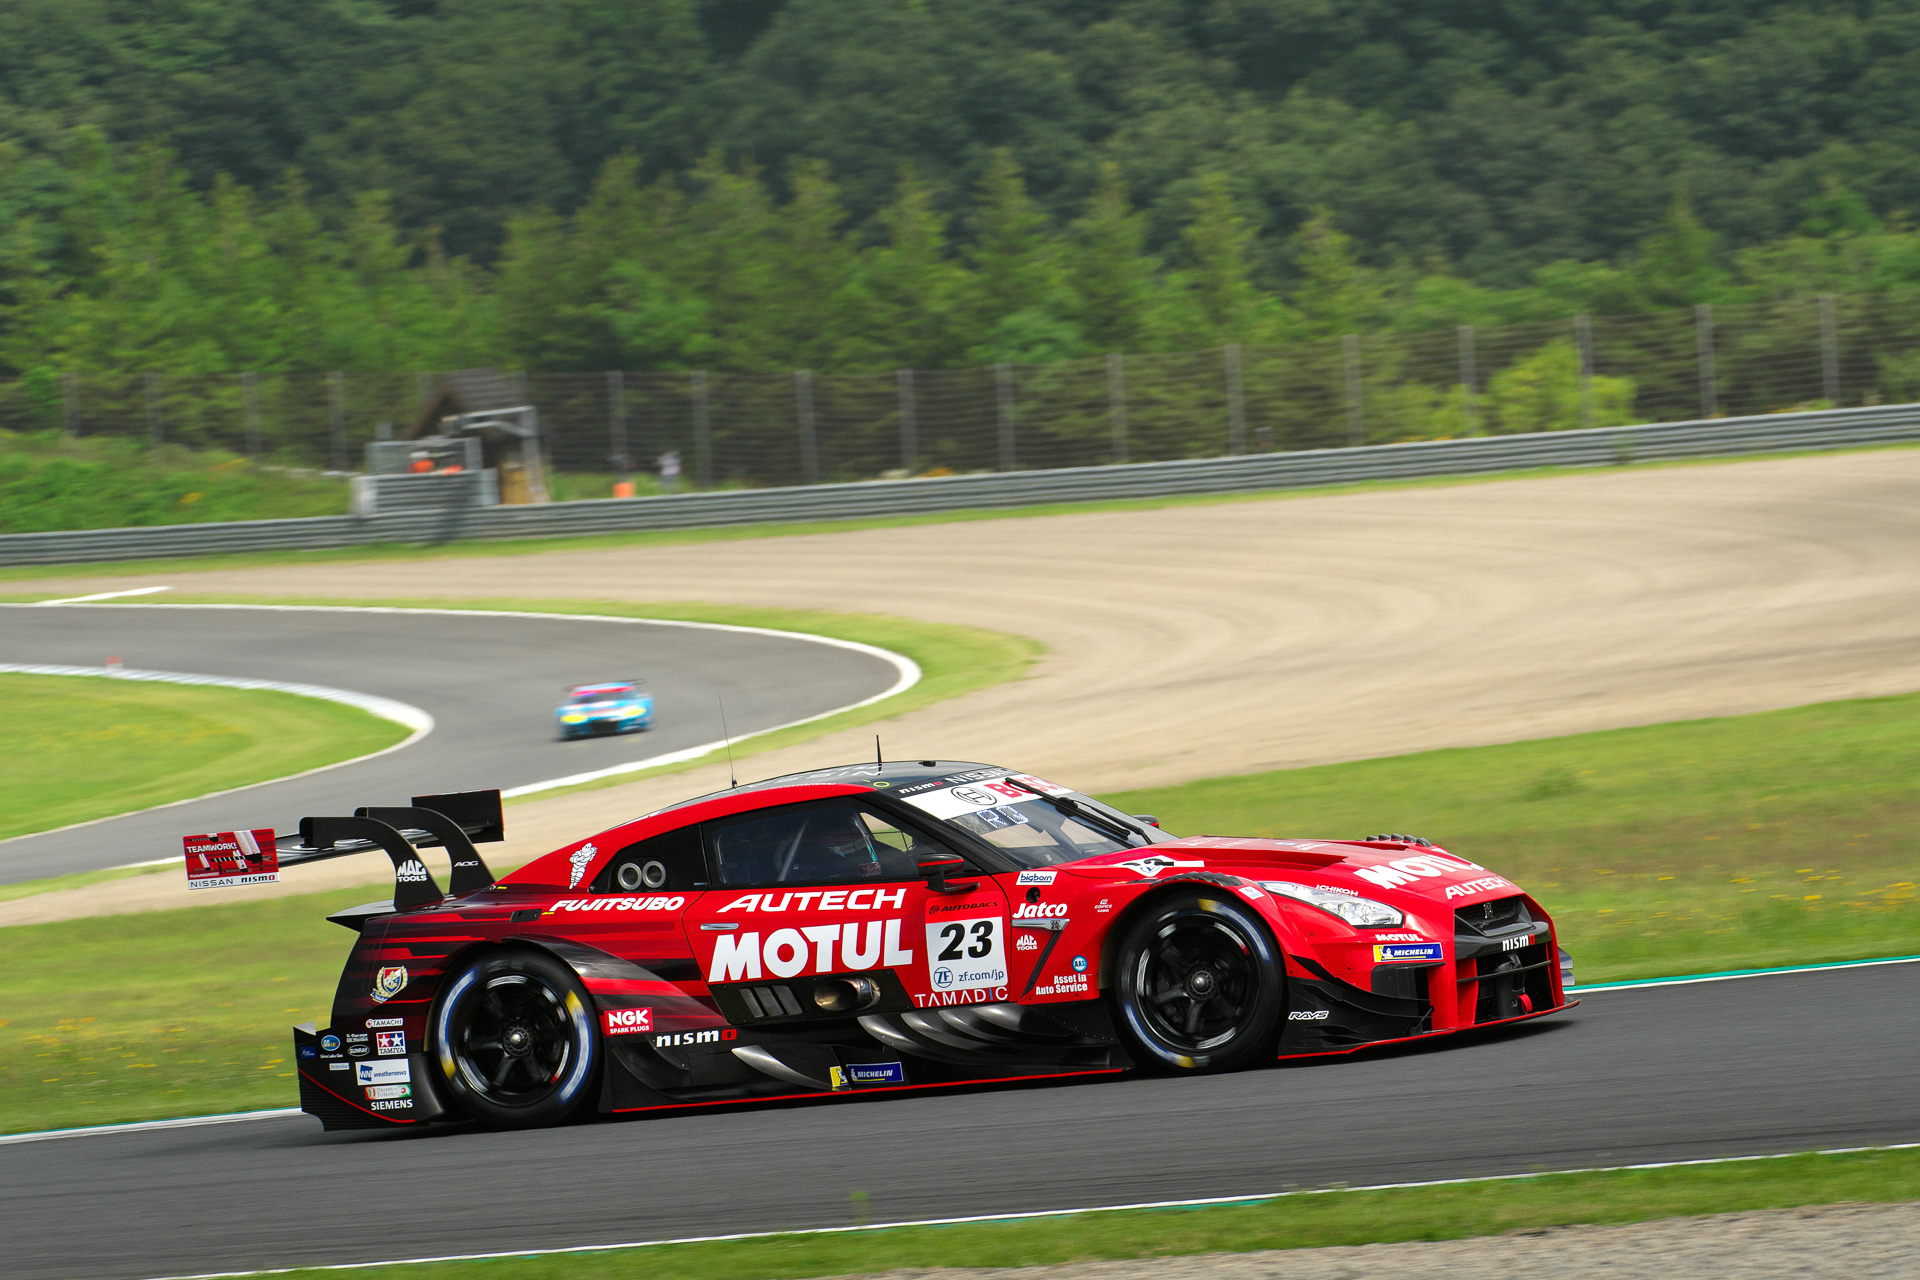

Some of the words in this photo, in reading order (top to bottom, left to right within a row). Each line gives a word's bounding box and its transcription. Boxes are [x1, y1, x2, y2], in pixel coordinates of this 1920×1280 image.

[898, 781, 944, 794] nismo
[983, 776, 1063, 798] BOSC
[186, 842, 238, 853] TEAMWORK!
[397, 859, 427, 876] MAC
[1353, 848, 1486, 890] MOTUL
[190, 878, 234, 888] NISSAN
[241, 874, 275, 883] nismo
[397, 874, 427, 882] TOOLS
[1315, 884, 1359, 897] ICHIKOH
[1445, 877, 1510, 900] AUTECH
[548, 896, 685, 912] FUJITSUBO
[716, 888, 907, 913] AUTECH
[940, 900, 999, 912] AUTOBACS
[1012, 902, 1068, 919] Jatco
[937, 920, 994, 962] 23
[1016, 934, 1038, 946] MAC
[1375, 933, 1424, 942] MOTUL
[1502, 933, 1536, 951] nismo
[708, 918, 914, 983] MOTUL
[1393, 948, 1434, 957] MICHELIN
[936, 971, 950, 984] ZF
[958, 968, 1004, 983] zf.com/jp
[1053, 974, 1077, 984] Asset
[1077, 973, 1087, 982] in
[1035, 985, 1055, 995] Auto
[1055, 982, 1088, 993] Service
[914, 986, 1009, 1008] TAMADIC
[608, 1009, 649, 1027] NGK
[1288, 1010, 1330, 1021] RAYS
[656, 1028, 738, 1048] nismo
[373, 1070, 407, 1078] weathernews
[857, 1069, 893, 1078] MICHELIN
[371, 1099, 414, 1111] SIEMENS
